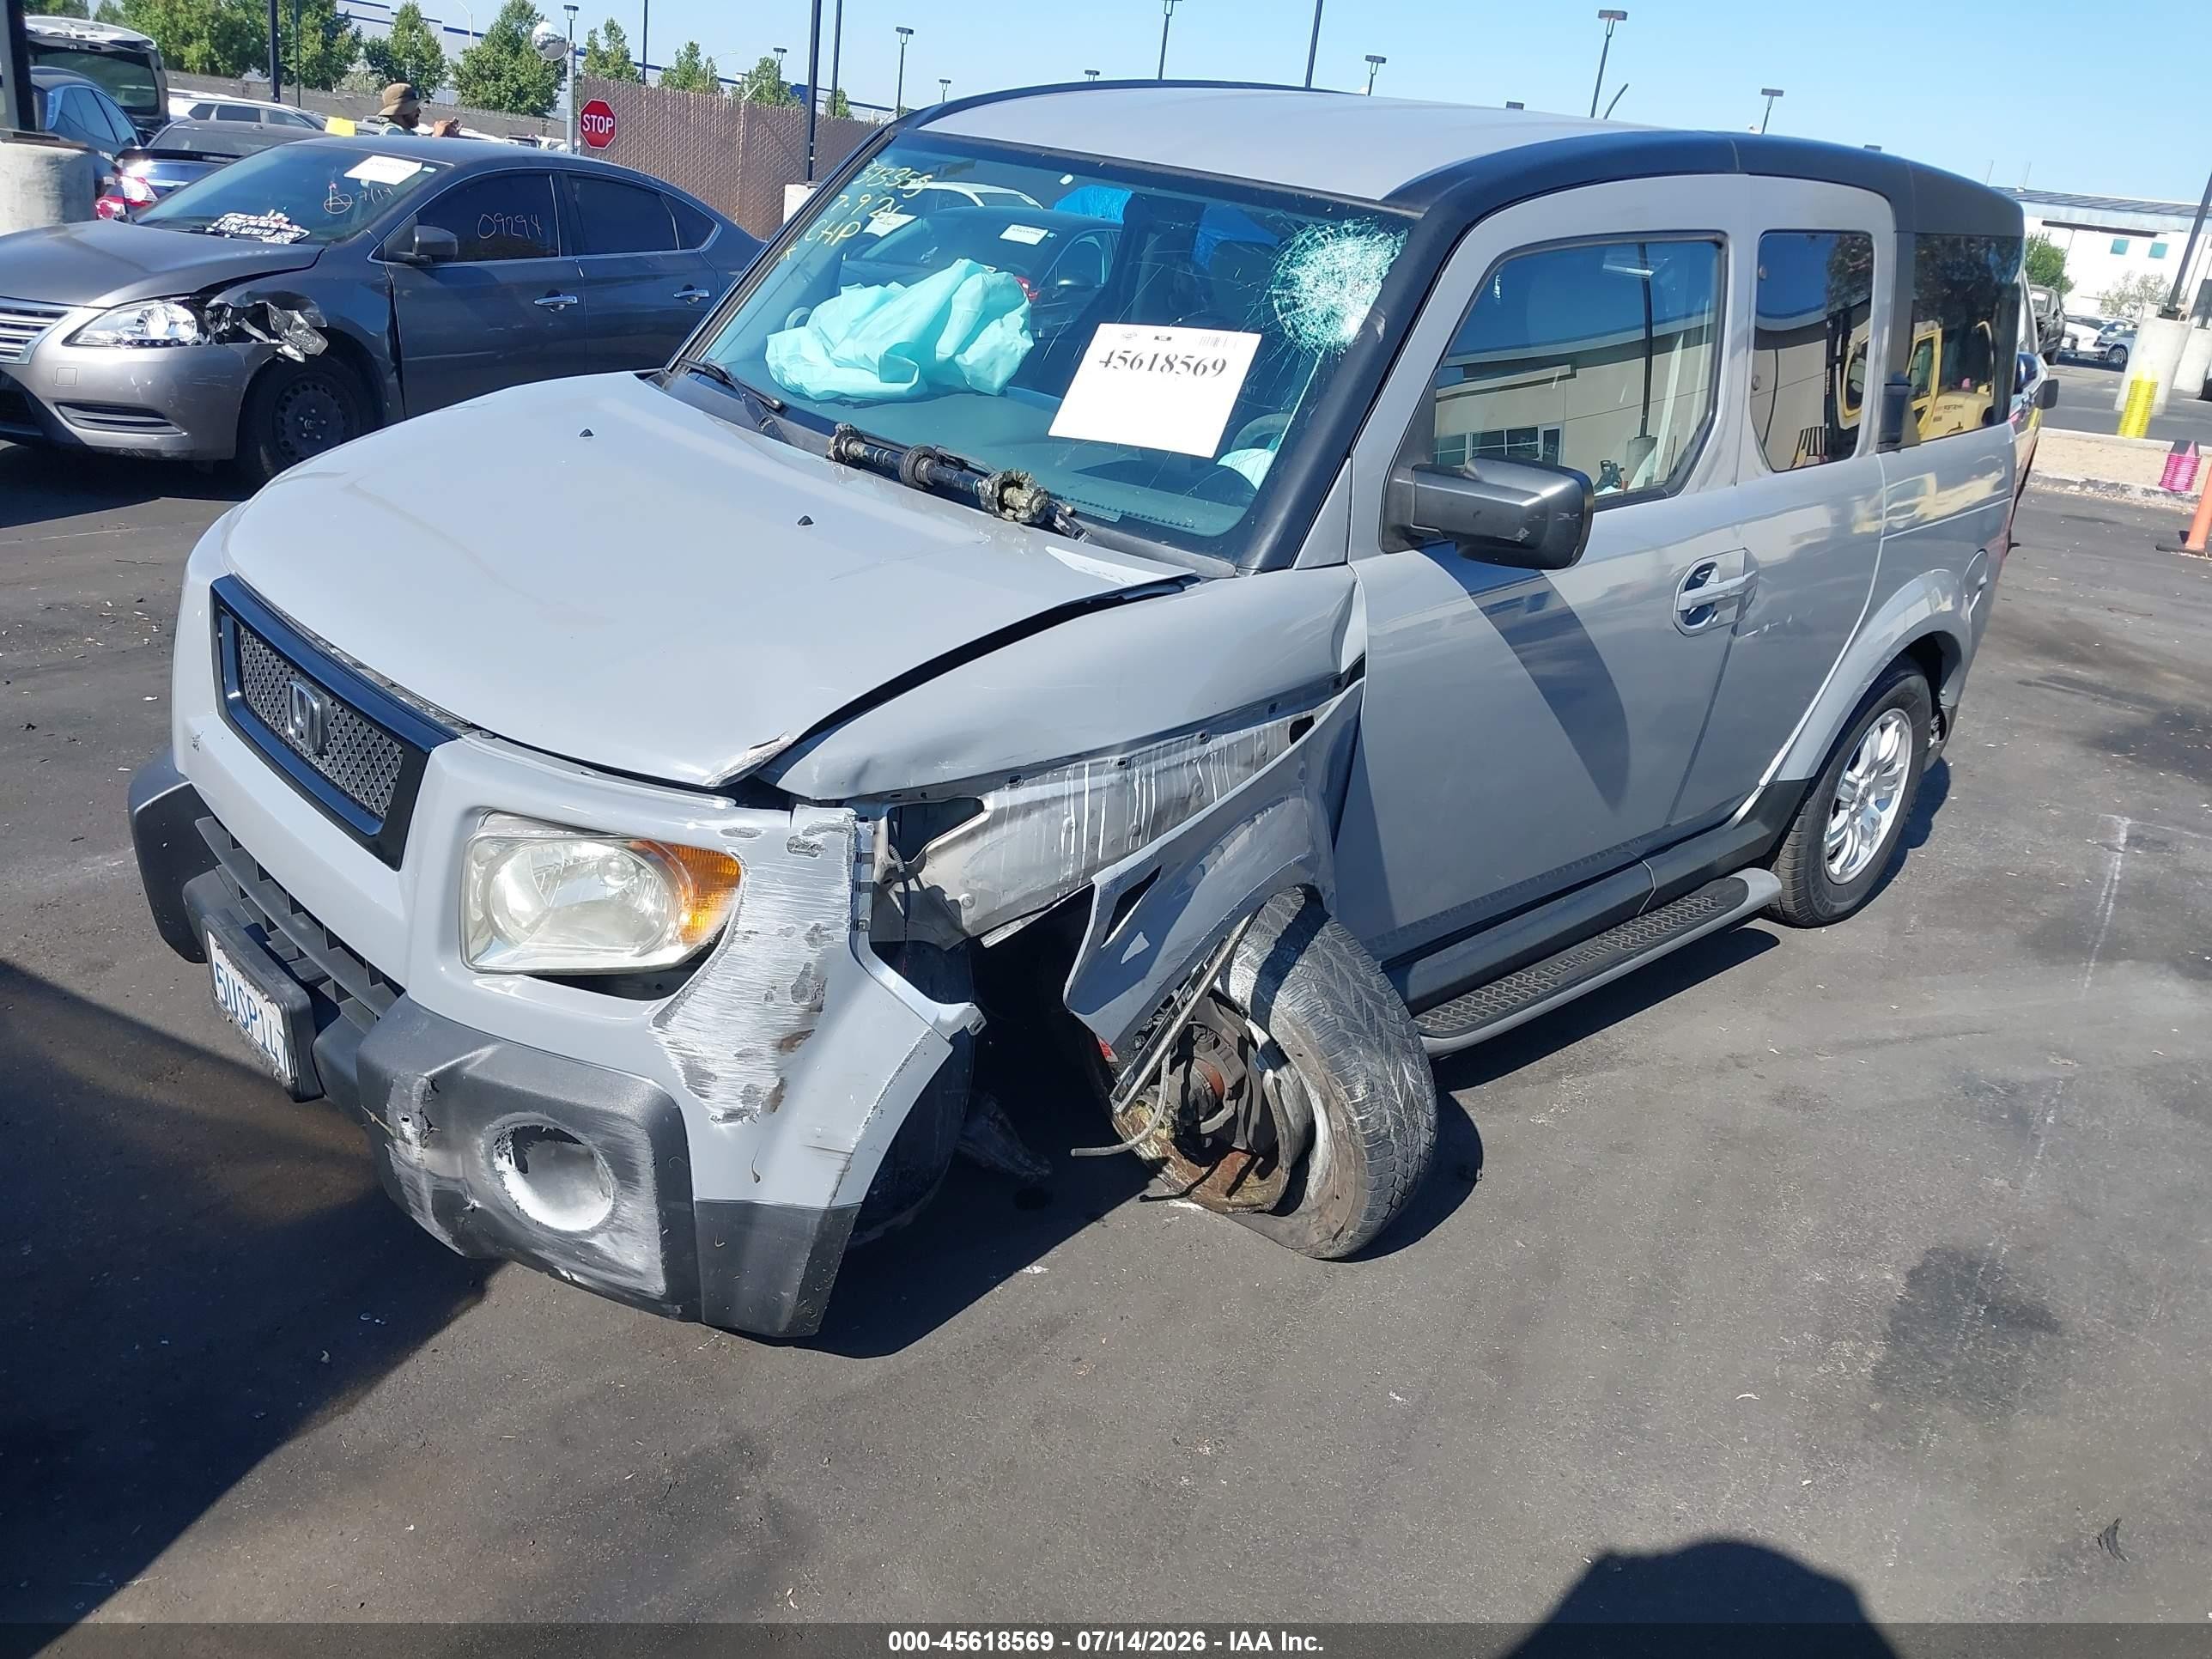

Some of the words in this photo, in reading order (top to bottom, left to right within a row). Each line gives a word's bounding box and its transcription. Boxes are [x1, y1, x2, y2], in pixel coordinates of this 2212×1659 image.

[582, 113, 614, 134] STOP
[477, 212, 543, 240] 09294
[805, 219, 861, 246] CHP
[1099, 349, 1227, 378] 45618569
